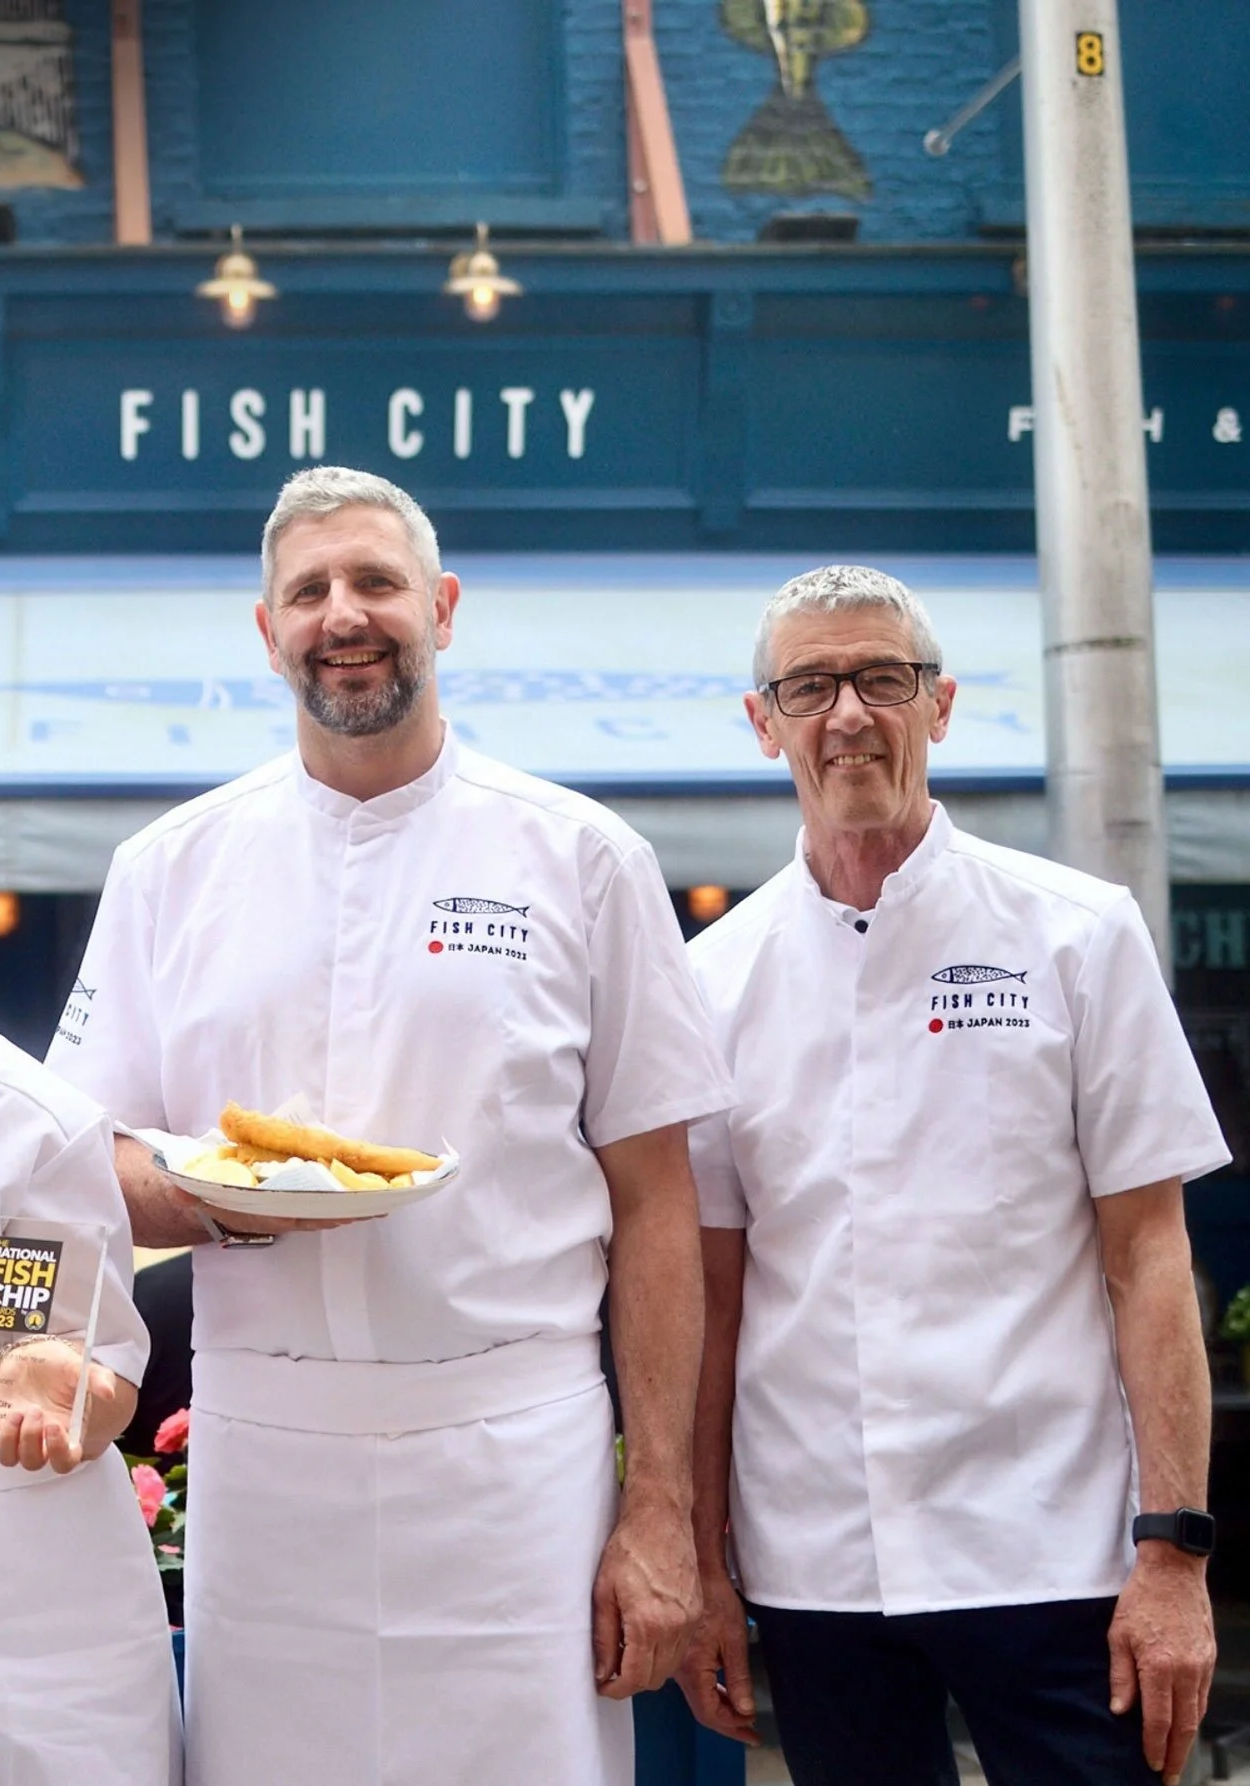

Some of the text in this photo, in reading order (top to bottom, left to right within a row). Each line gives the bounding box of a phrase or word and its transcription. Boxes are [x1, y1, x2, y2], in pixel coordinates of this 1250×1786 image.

[1078, 33, 1102, 75] 8
[120, 388, 595, 461] FISH CITY
[1212, 407, 1243, 443] &
[430, 920, 529, 942] FISH CITY
[1172, 911, 1250, 968] CH
[468, 944, 501, 954] JAPAN
[506, 948, 527, 960] 2023
[931, 992, 1028, 1011] FISH CITY
[967, 1018, 1002, 1028] JAPAN
[1006, 1018, 1030, 1028] 2023
